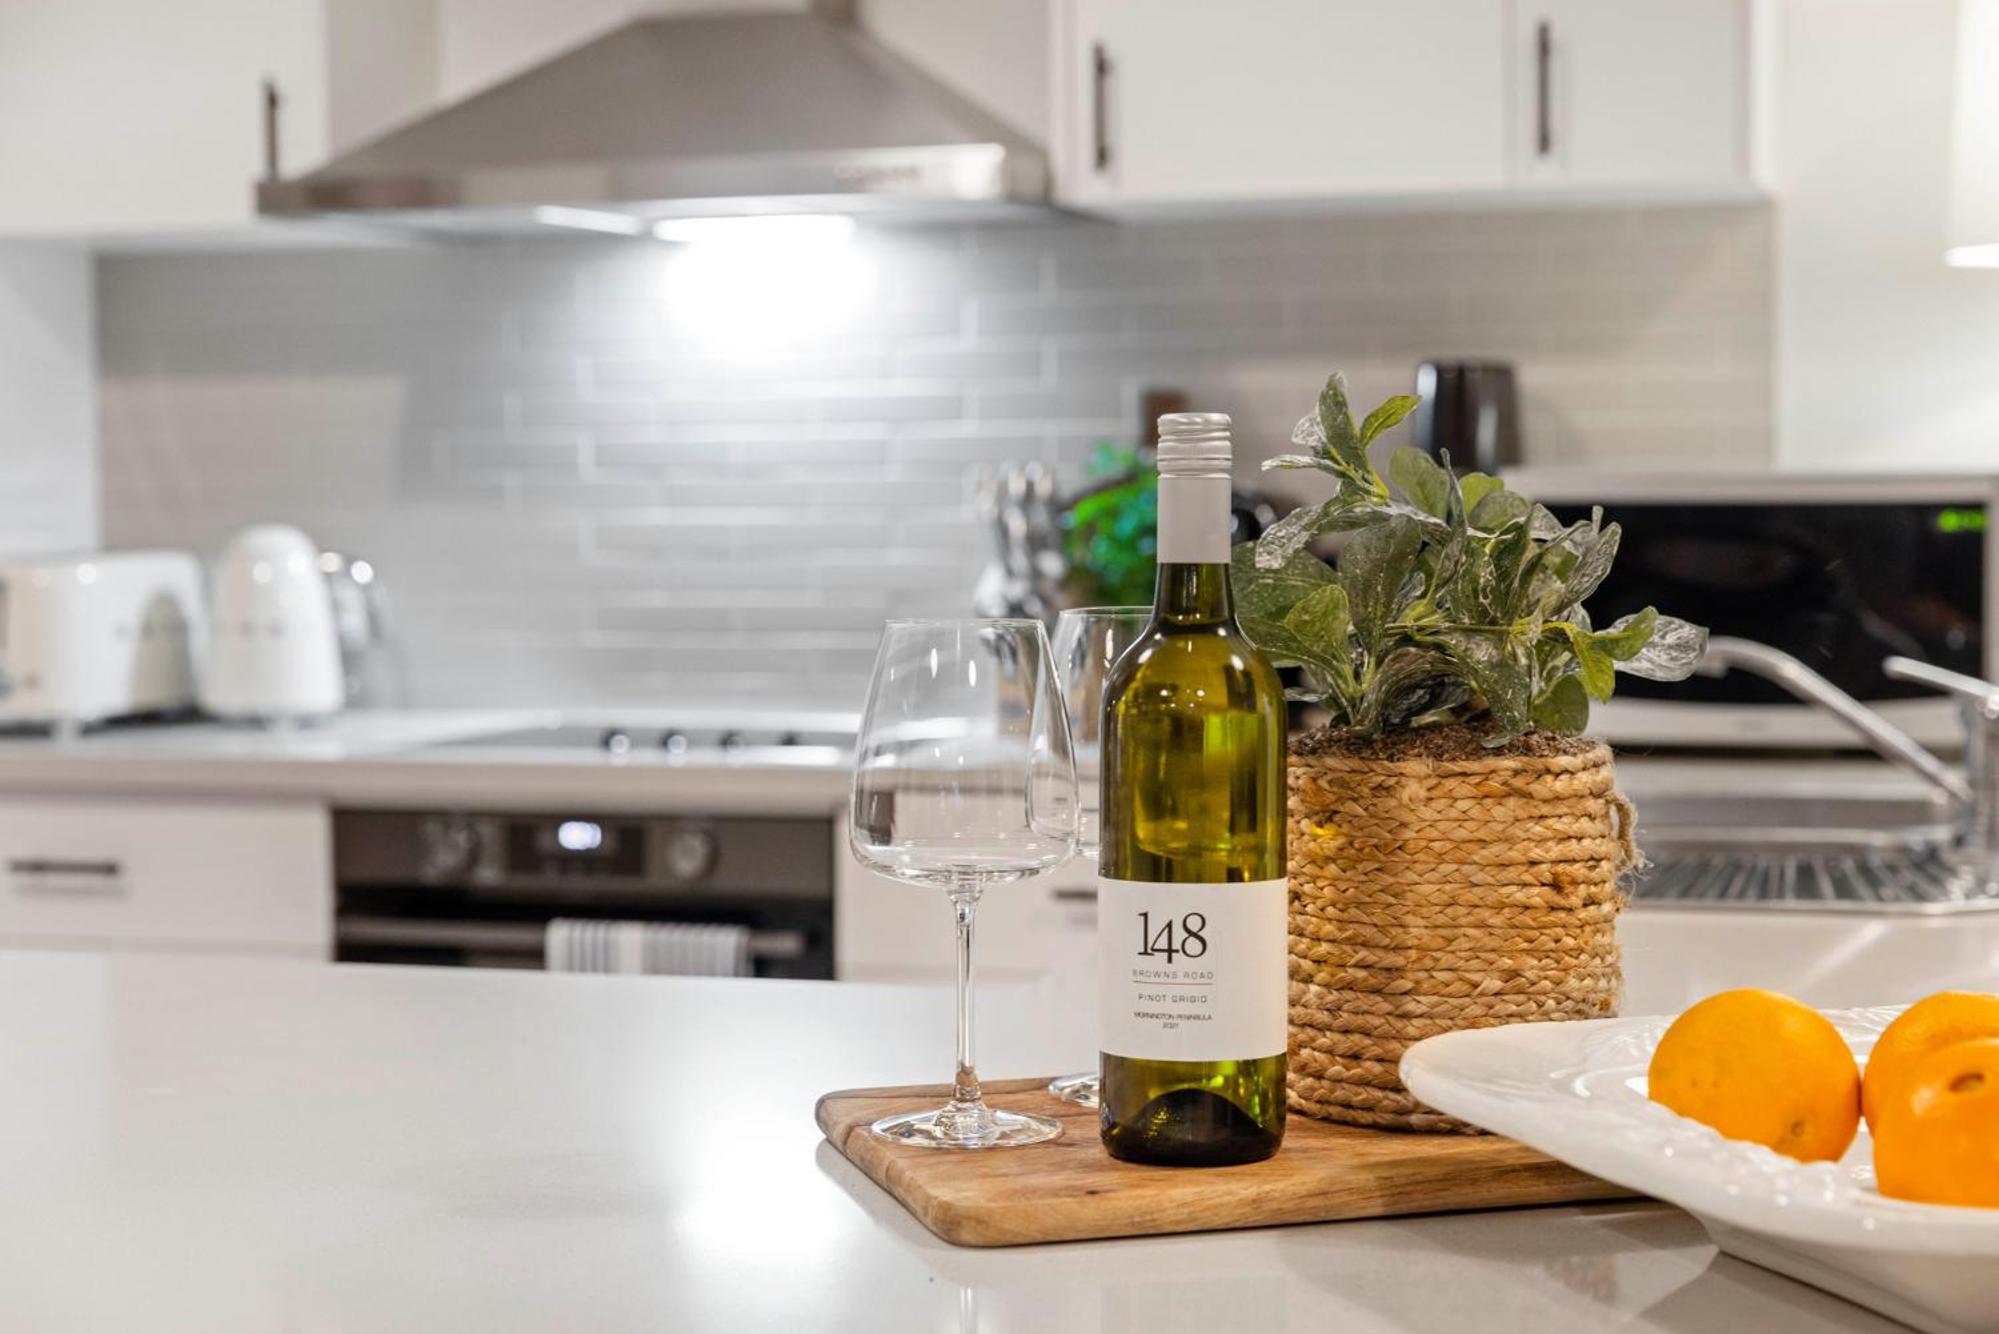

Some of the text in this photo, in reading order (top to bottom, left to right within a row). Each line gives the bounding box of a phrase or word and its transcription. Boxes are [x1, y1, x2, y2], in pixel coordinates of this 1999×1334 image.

[1137, 911, 1208, 964] 148
[1132, 969, 1214, 980] BROWNS ROAD
[1138, 994, 1208, 1004] PINOT GRIGIO
